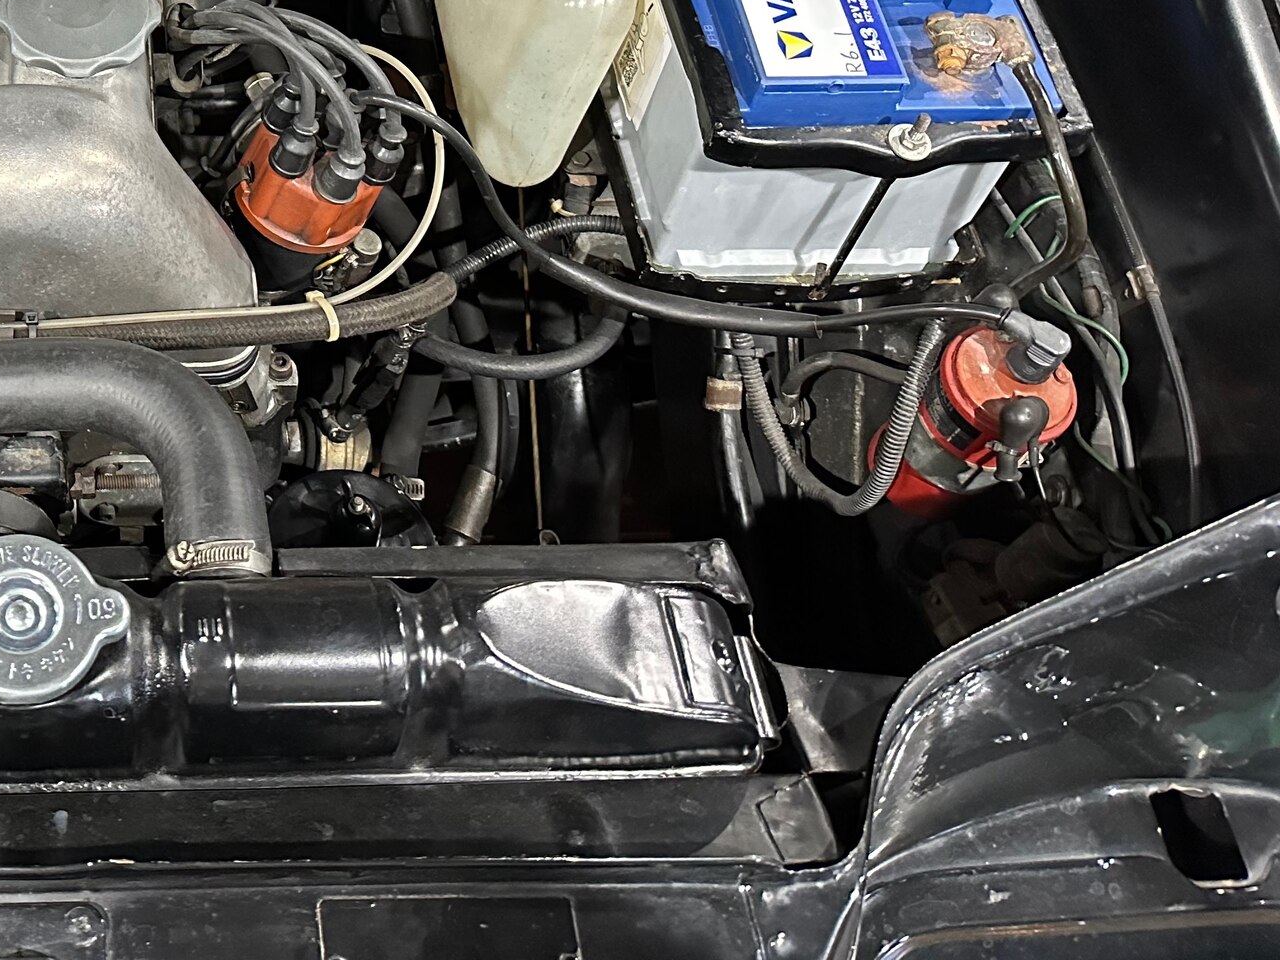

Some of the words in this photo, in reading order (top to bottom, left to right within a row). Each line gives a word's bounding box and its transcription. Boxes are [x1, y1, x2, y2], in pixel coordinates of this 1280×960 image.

[849, 5, 865, 24] 12V
[859, 27, 888, 61] E43
[22, 545, 80, 588] SLOWLY
